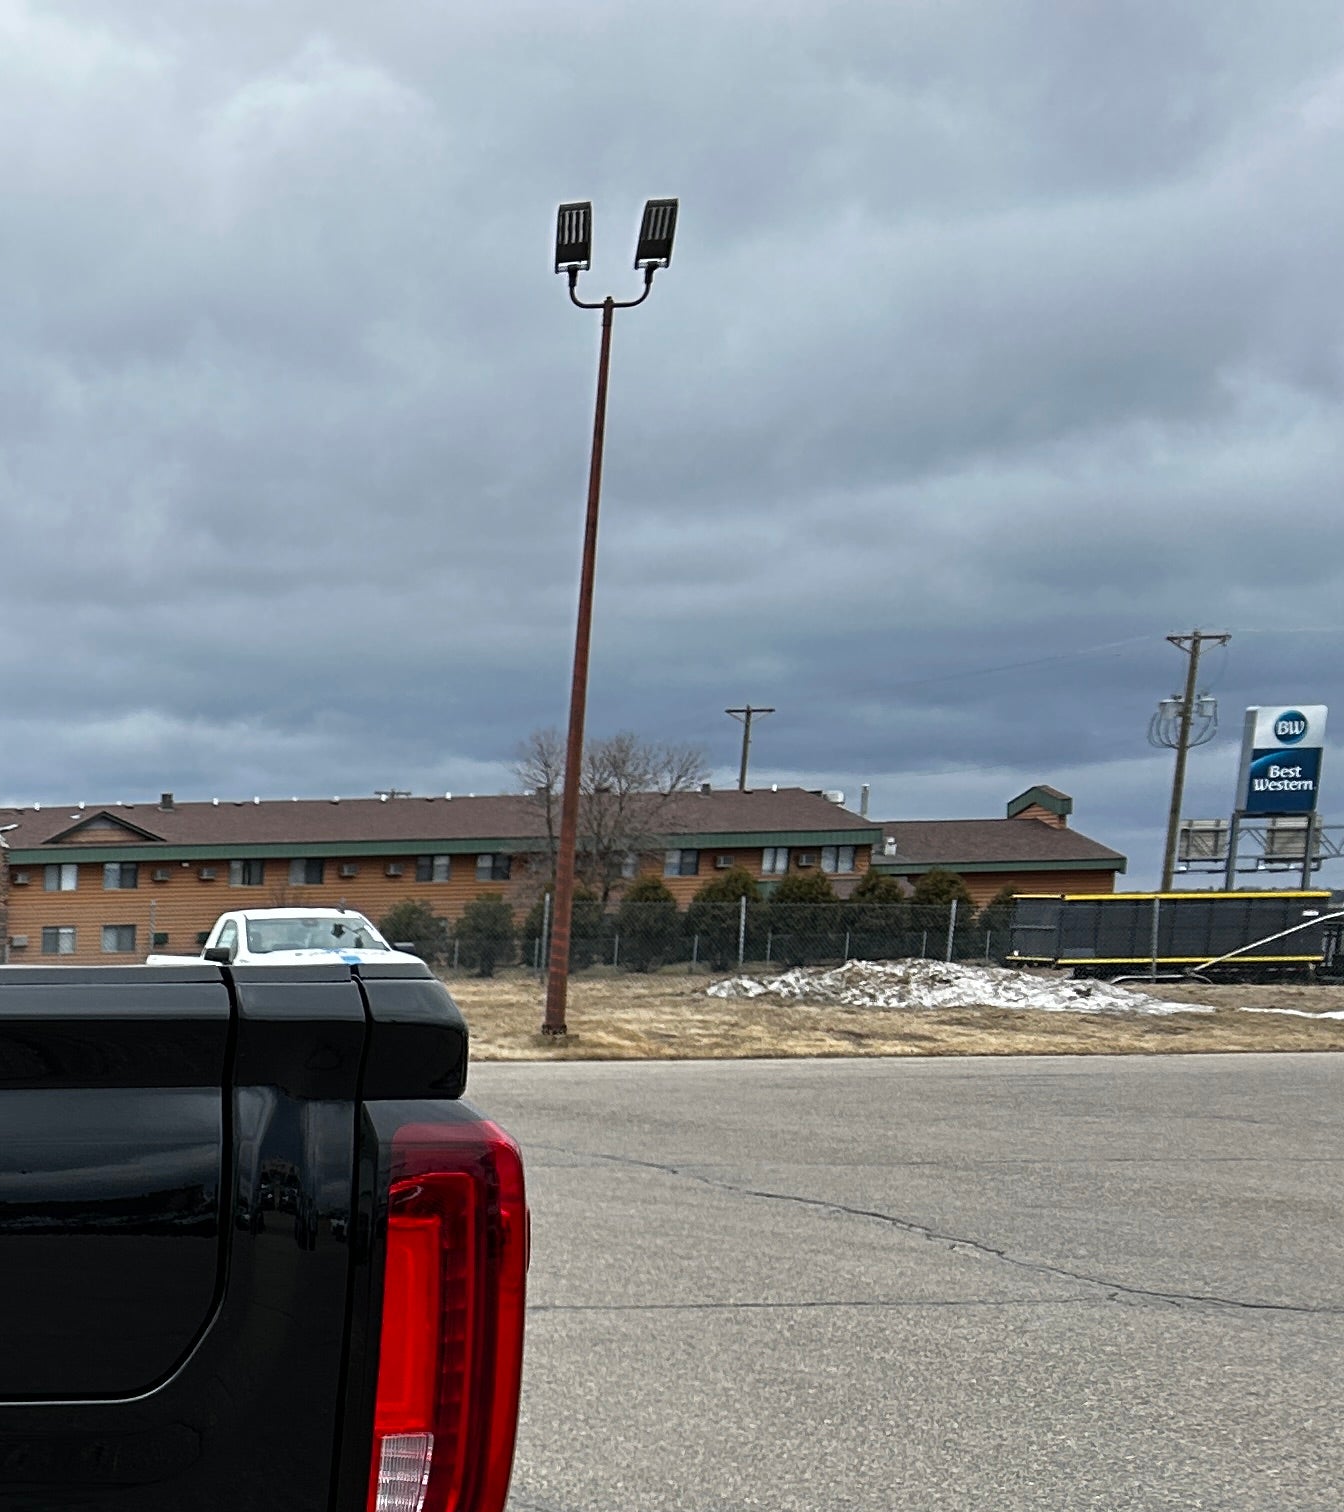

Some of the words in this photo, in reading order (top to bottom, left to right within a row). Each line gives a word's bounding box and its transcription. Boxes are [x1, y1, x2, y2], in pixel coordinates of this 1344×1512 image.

[1277, 720, 1305, 735] BW
[1269, 765, 1302, 778] Best
[1254, 779, 1314, 791] Western
